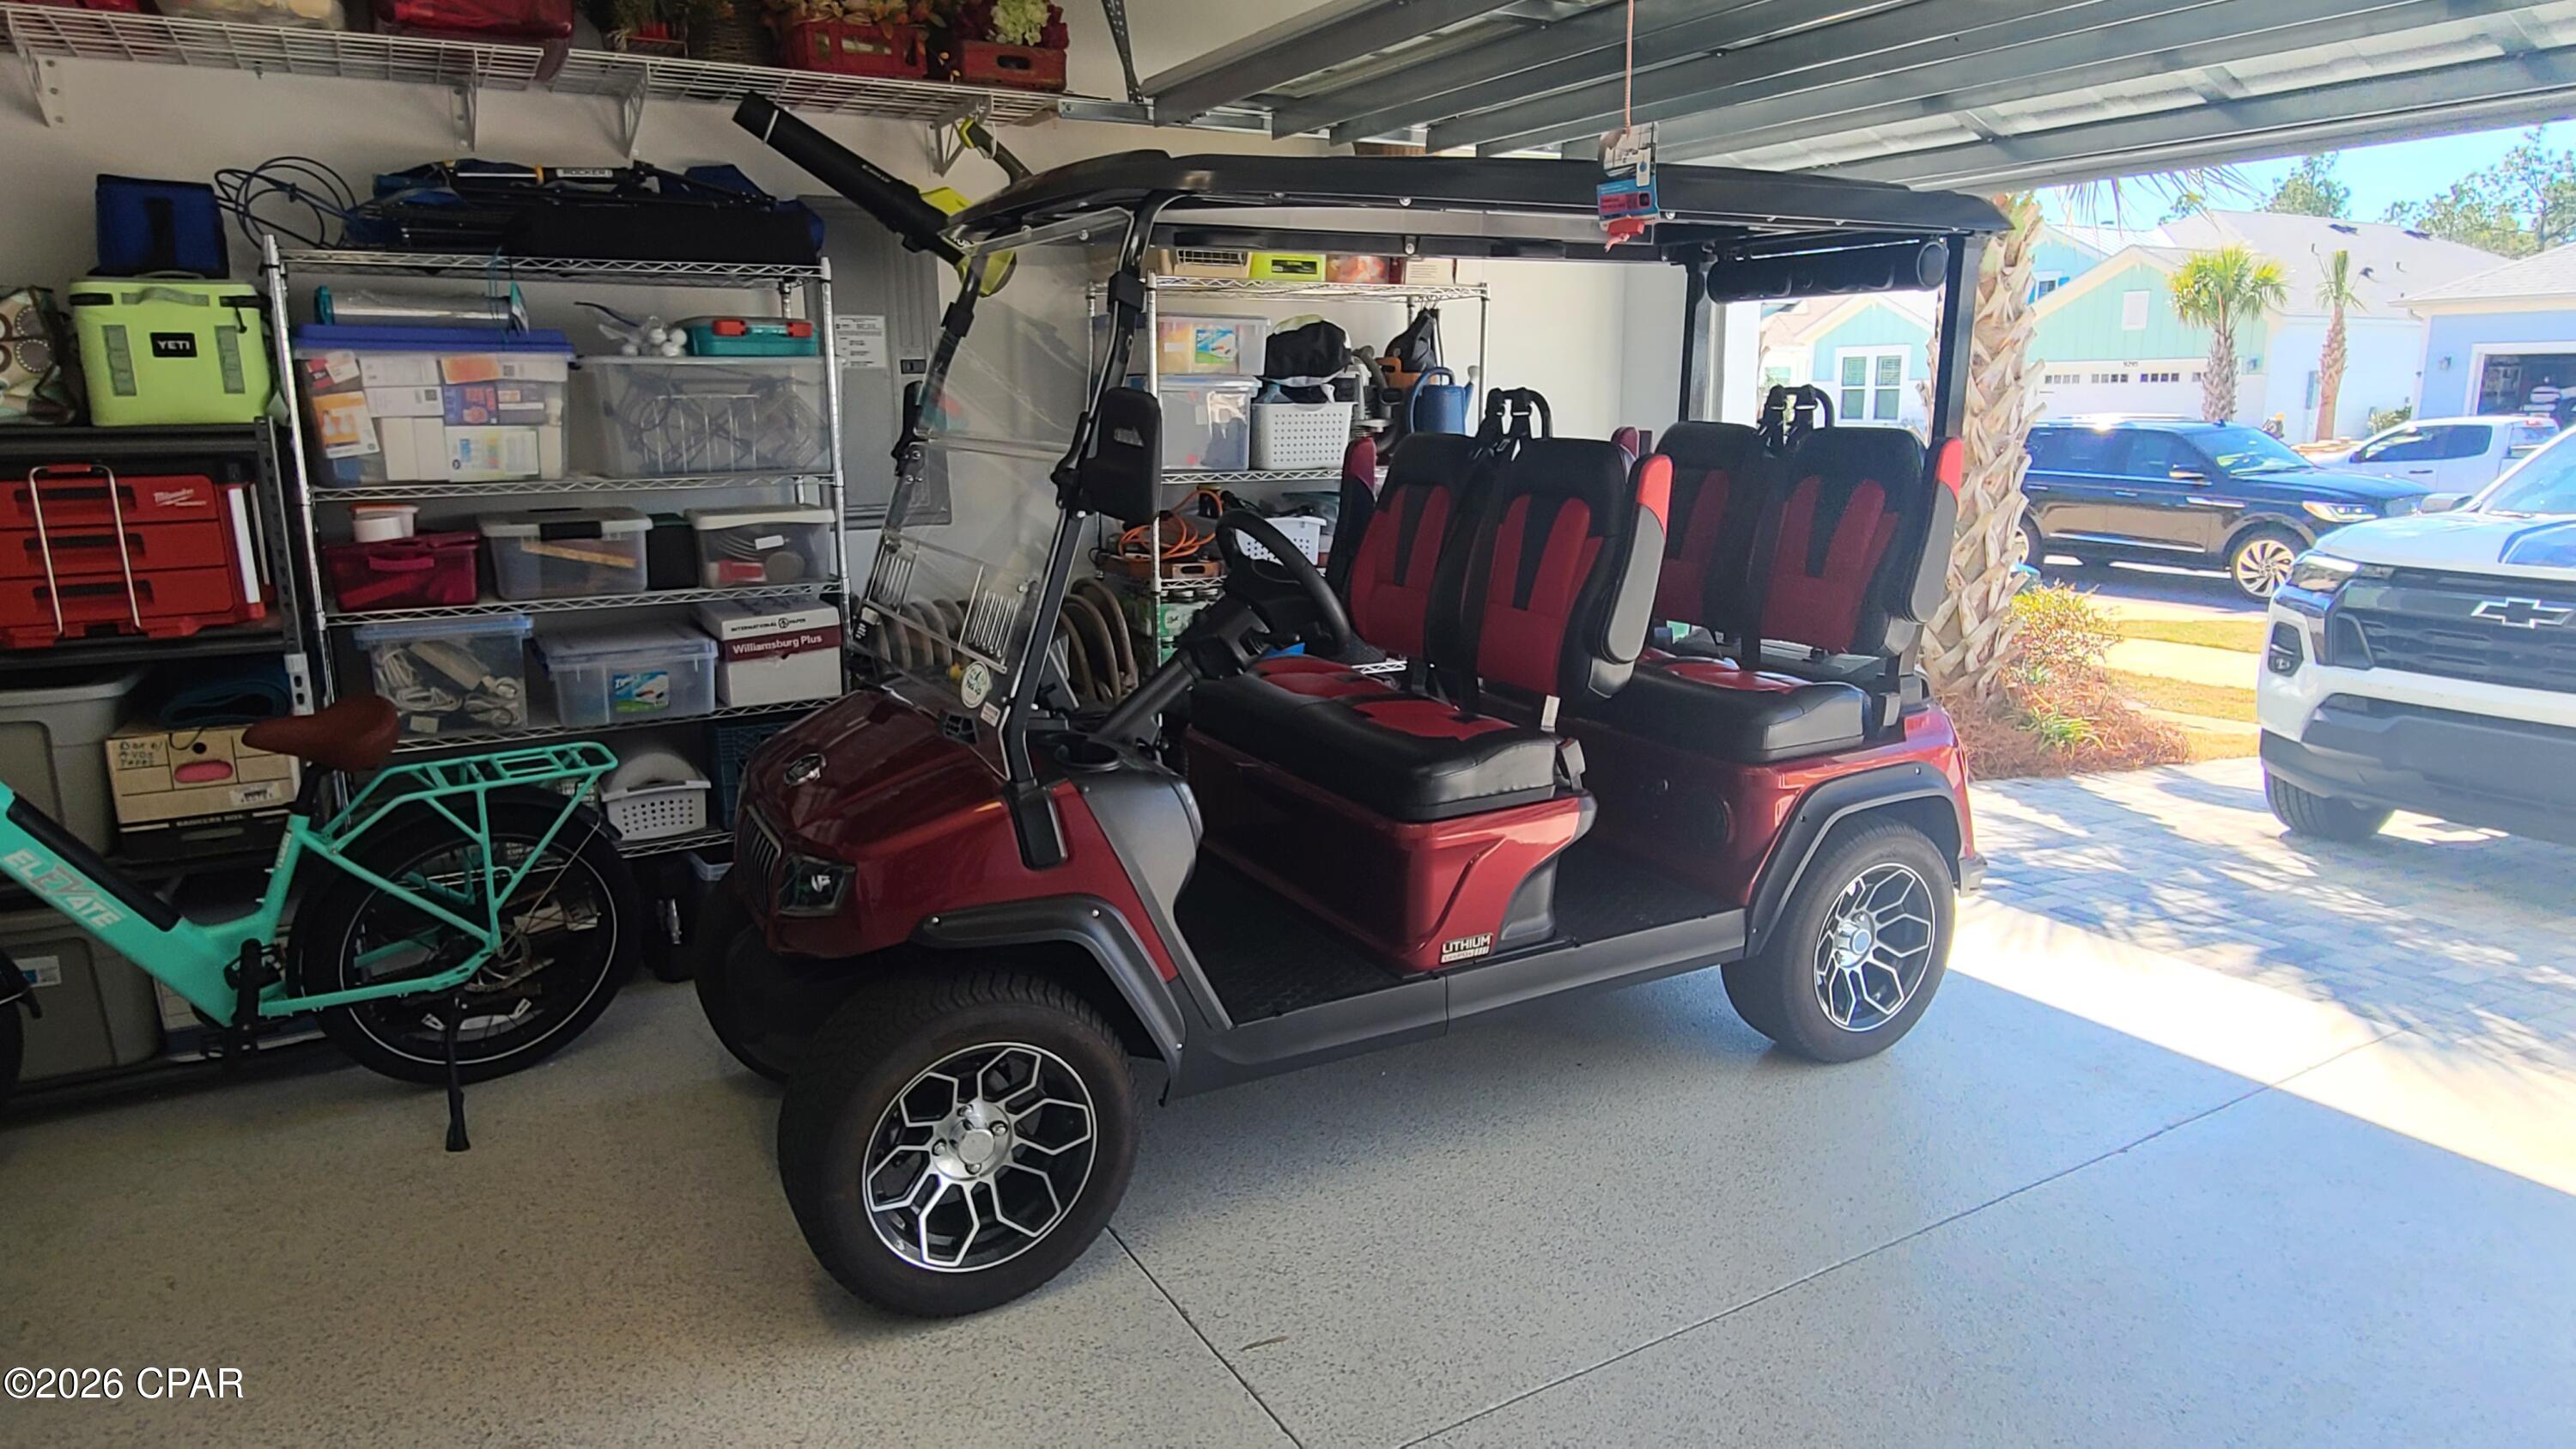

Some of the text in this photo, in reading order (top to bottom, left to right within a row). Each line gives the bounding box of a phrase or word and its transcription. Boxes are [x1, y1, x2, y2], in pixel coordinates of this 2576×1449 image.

[157, 340, 191, 350] YETI
[731, 621, 777, 632] INTERNATIONAL
[732, 634, 823, 655] Williamsburg Plus
[1443, 934, 1492, 954] LITHIUM
